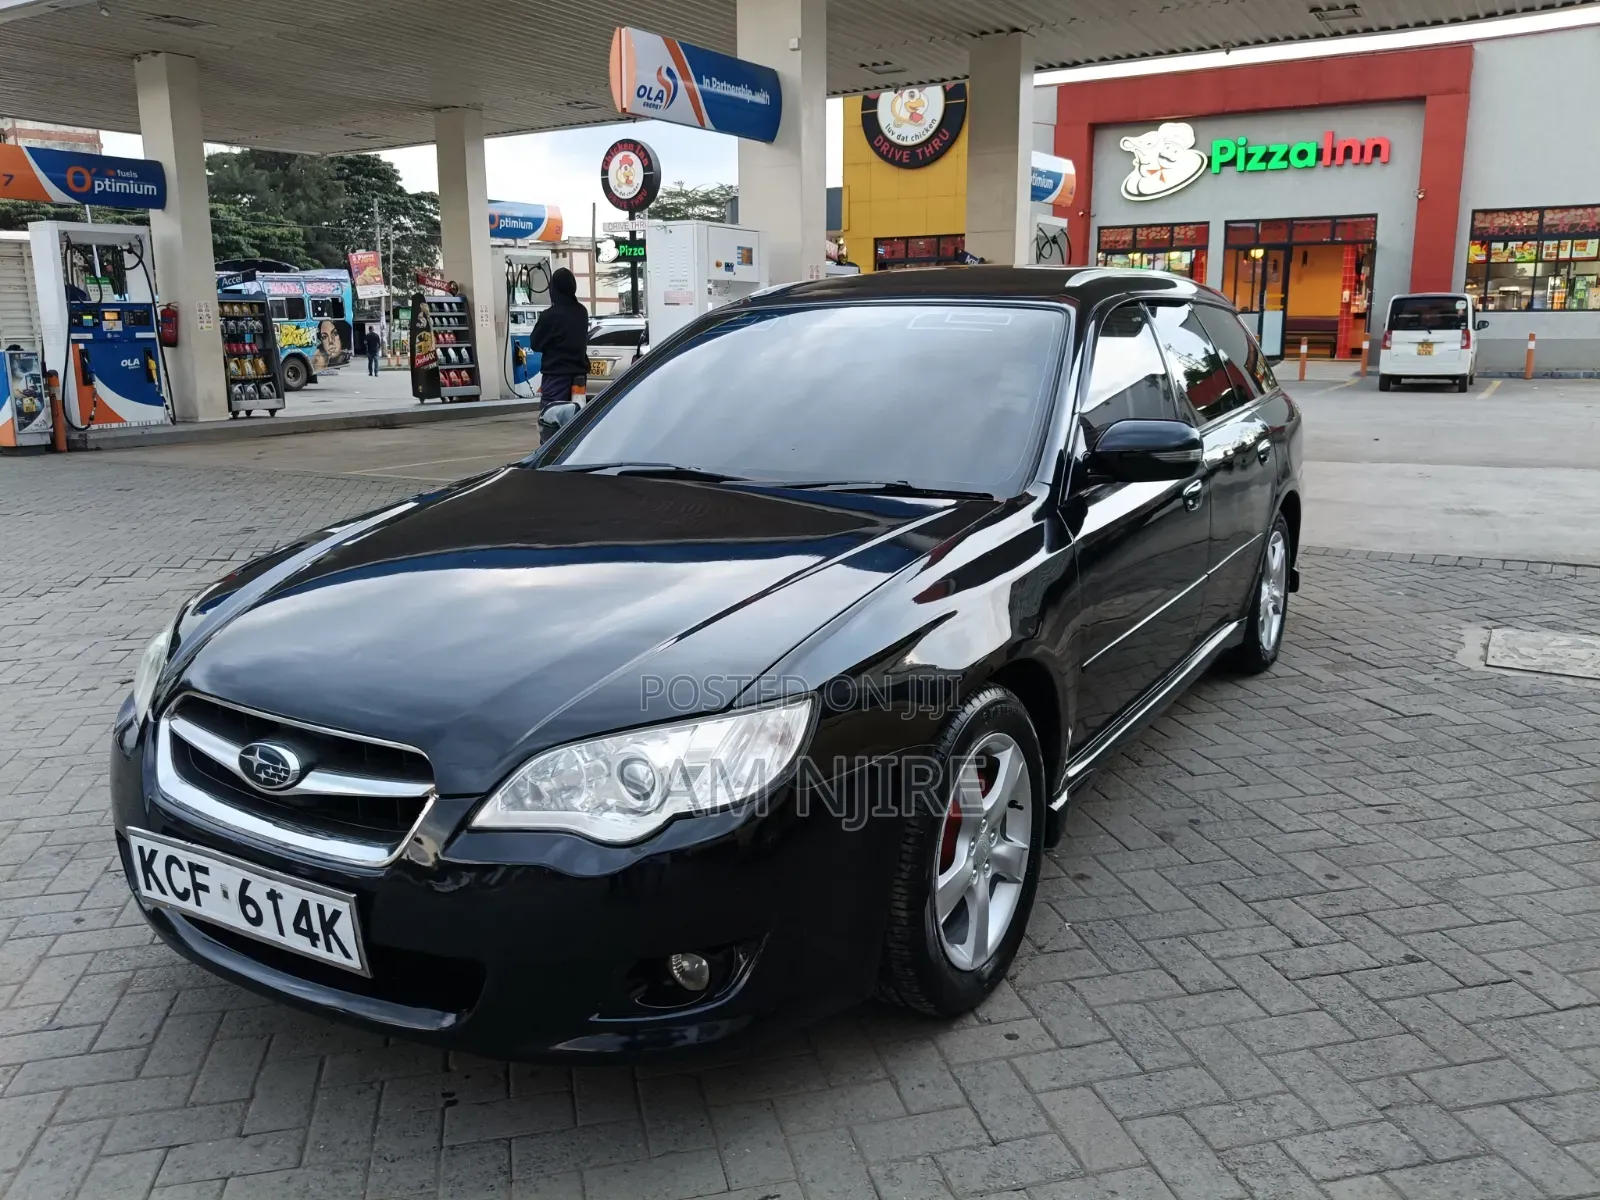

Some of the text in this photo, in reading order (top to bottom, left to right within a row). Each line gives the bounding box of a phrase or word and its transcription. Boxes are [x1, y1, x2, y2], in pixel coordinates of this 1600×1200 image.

[636, 84, 665, 104] OLA
[702, 75, 711, 88] In
[711, 77, 753, 102] Partnership
[885, 118, 937, 142] luv dat chicken
[603, 142, 634, 170] Chicken
[873, 129, 950, 163] DRIVE THRU
[1211, 136, 1318, 174] Pizza
[3, 174, 14, 187] 7
[116, 169, 138, 178] fuels
[607, 188, 648, 209] DRIVE THRU
[608, 221, 646, 231] DRIVE THR
[619, 245, 645, 257] Pizza
[221, 274, 243, 287] Accel
[121, 358, 140, 367] OLA
[137, 846, 353, 961] KCF 614K
